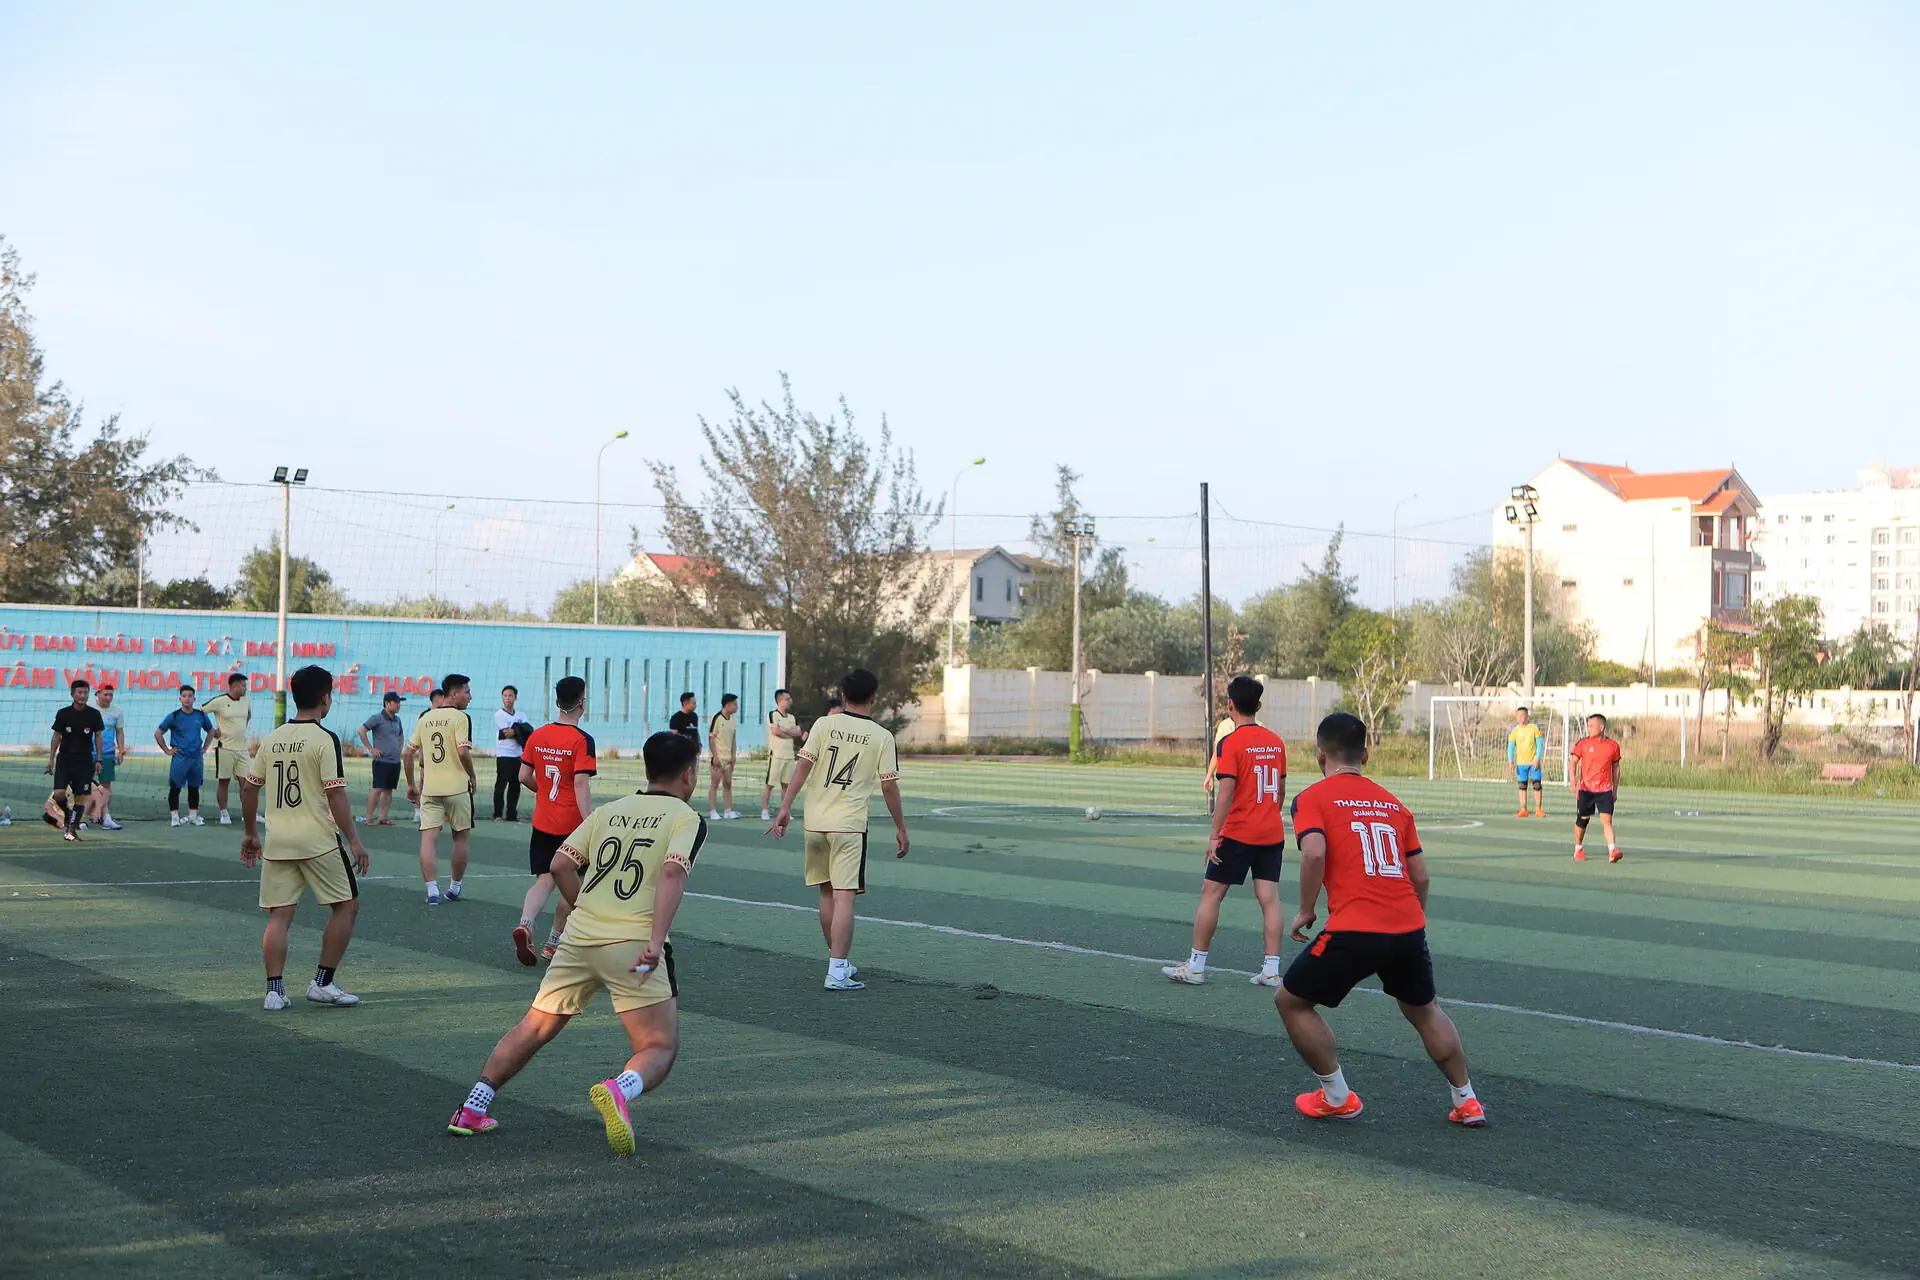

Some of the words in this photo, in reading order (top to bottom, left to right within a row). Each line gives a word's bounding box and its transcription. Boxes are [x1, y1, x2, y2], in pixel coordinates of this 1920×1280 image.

[33, 634, 76, 651] BAN
[85, 632, 143, 653] NHÂN
[153, 635, 196, 655] DÂN
[291, 642, 336, 658] NINH
[0, 661, 56, 688] TÂM
[366, 674, 435, 696] THAO
[272, 742, 286, 753] CN
[431, 732, 446, 763] 3
[830, 729, 845, 740] CN
[846, 733, 871, 746] HUẾ
[273, 760, 302, 809] 18
[545, 764, 562, 802] 7
[823, 745, 860, 791] 14
[1254, 764, 1279, 804] 14
[608, 814, 632, 829] CN
[1334, 799, 1372, 808] THACO
[1372, 799, 1400, 812] AUTO
[1350, 821, 1404, 878] 10
[581, 836, 656, 901] 95
